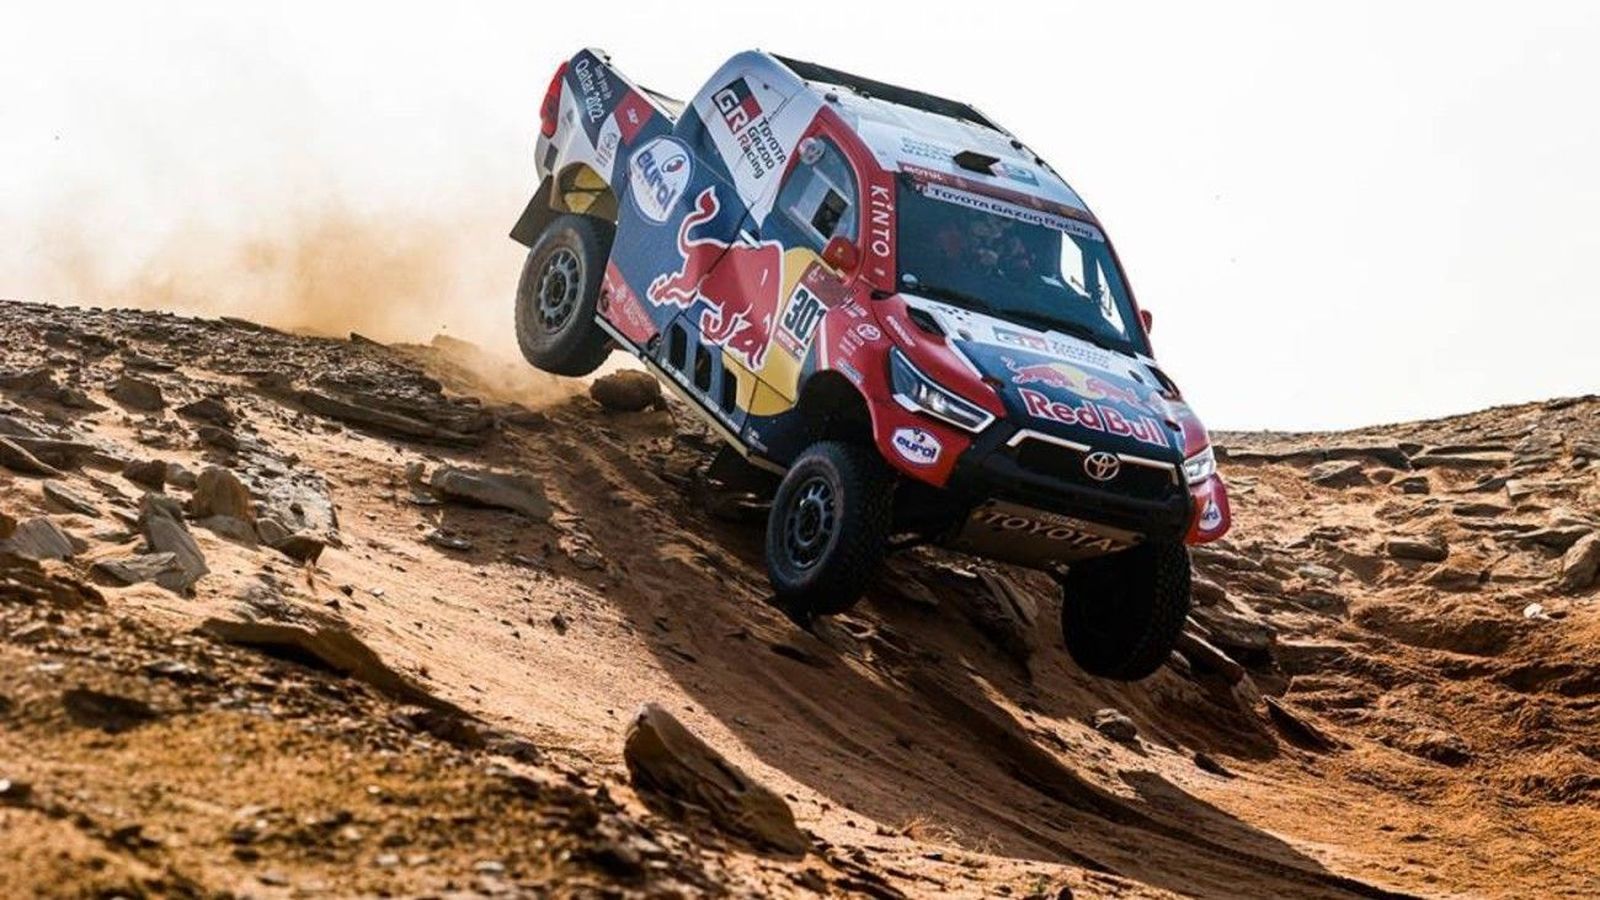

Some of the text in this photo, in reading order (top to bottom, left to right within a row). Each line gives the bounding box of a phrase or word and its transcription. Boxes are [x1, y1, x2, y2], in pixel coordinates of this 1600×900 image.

[575, 58, 595, 97] Qatar
[586, 91, 605, 123] 2022
[713, 88, 750, 132] GR
[737, 133, 765, 179] Racing
[747, 126, 775, 170] GAZOO
[758, 117, 786, 164] TOYOTA
[636, 150, 677, 213] eurol
[931, 186, 991, 209] TOYOTA
[990, 202, 1044, 224] GAZOO
[1044, 217, 1094, 238] Racing
[784, 288, 827, 345] 301
[1017, 387, 1170, 449] Red Bull
[896, 436, 937, 459] eurol
[983, 513, 1115, 552] TOYOTA
